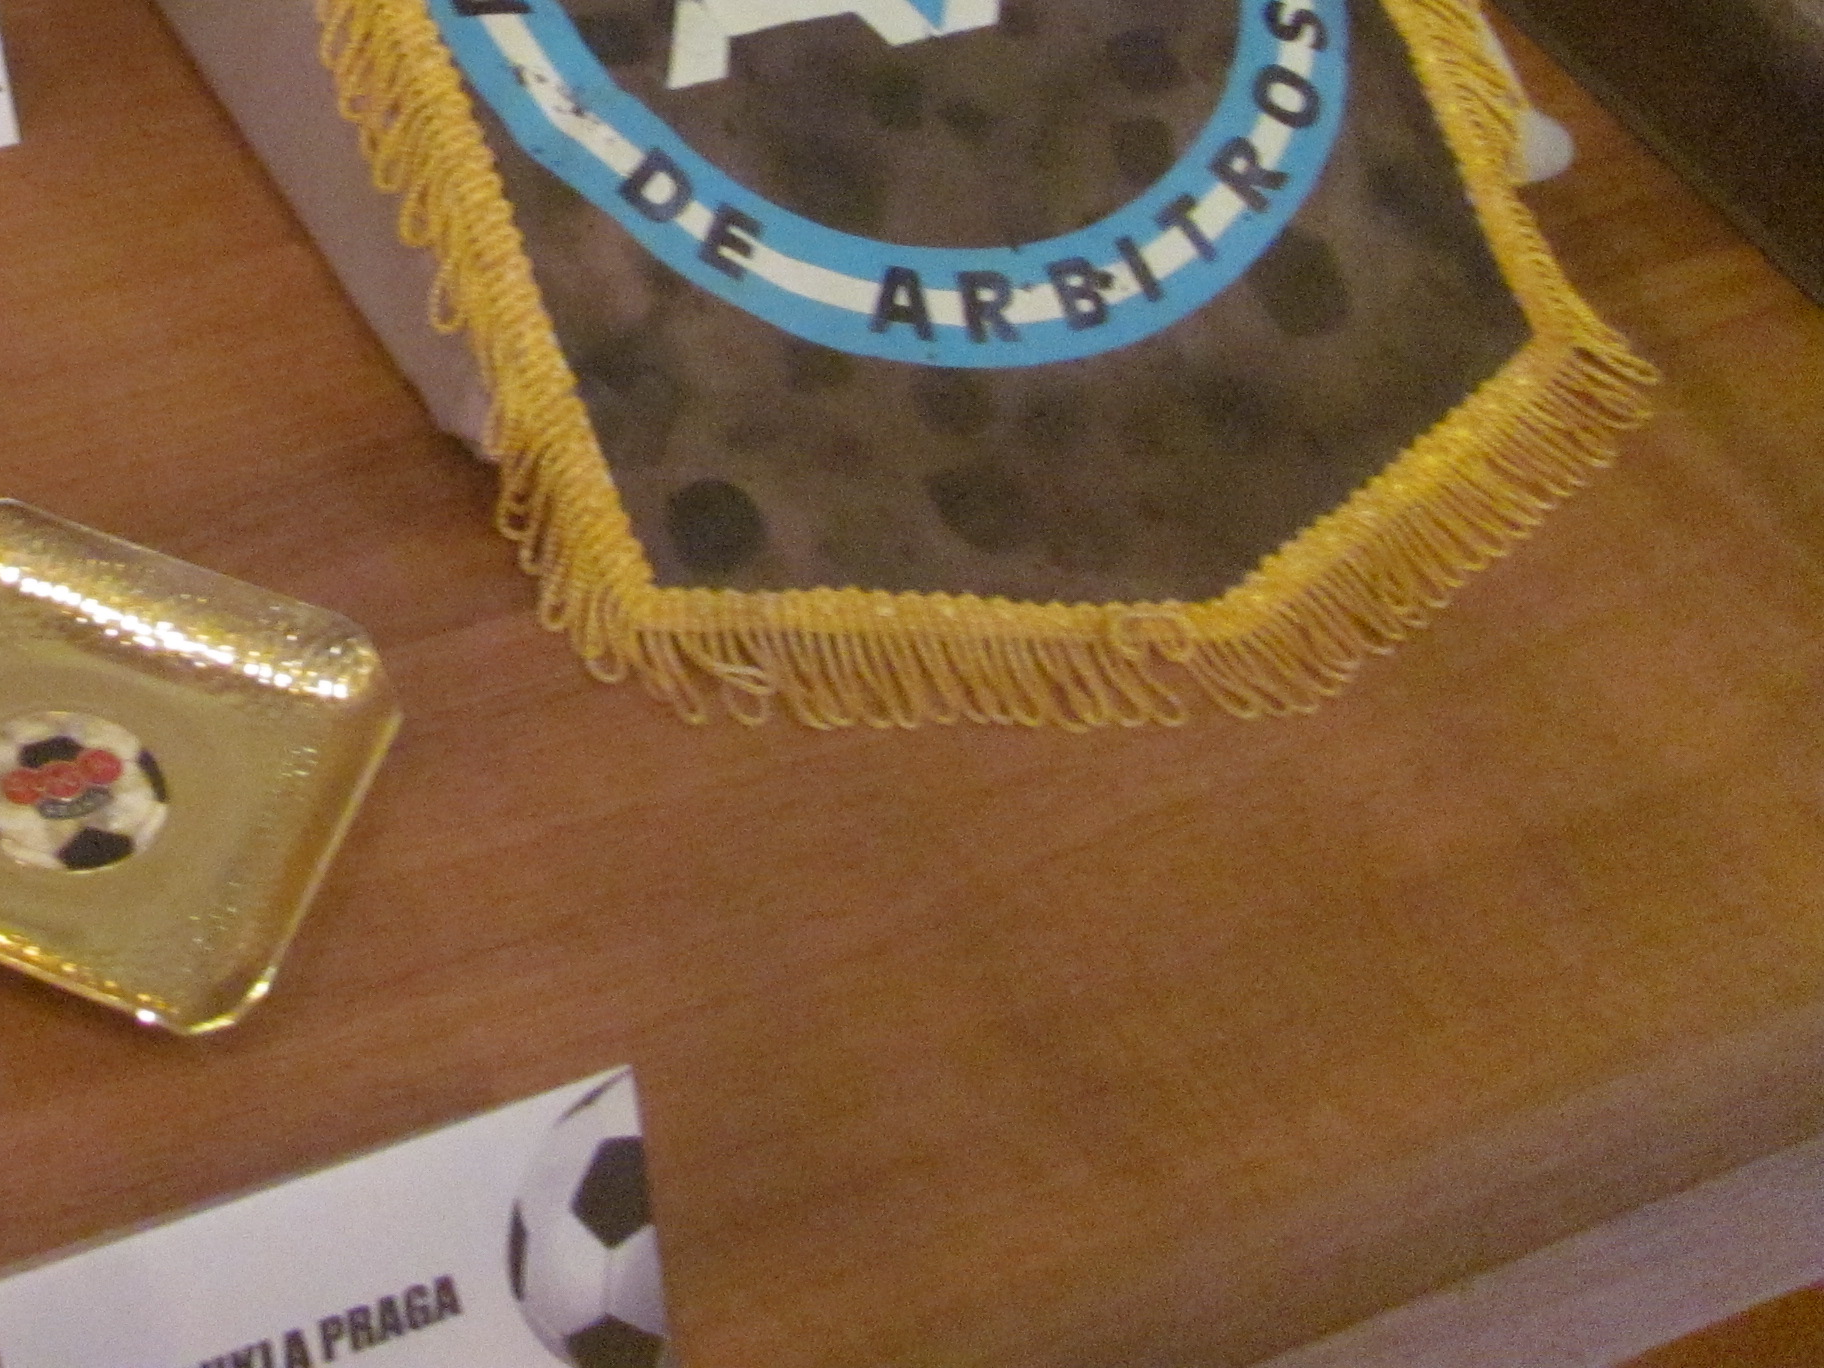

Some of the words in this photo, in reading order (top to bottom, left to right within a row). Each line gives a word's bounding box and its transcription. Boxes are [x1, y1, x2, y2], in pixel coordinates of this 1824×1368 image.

[617, 147, 768, 279] DE
[870, 0, 1329, 344] ARBITROS
[319, 1275, 464, 1363] PRAGA
